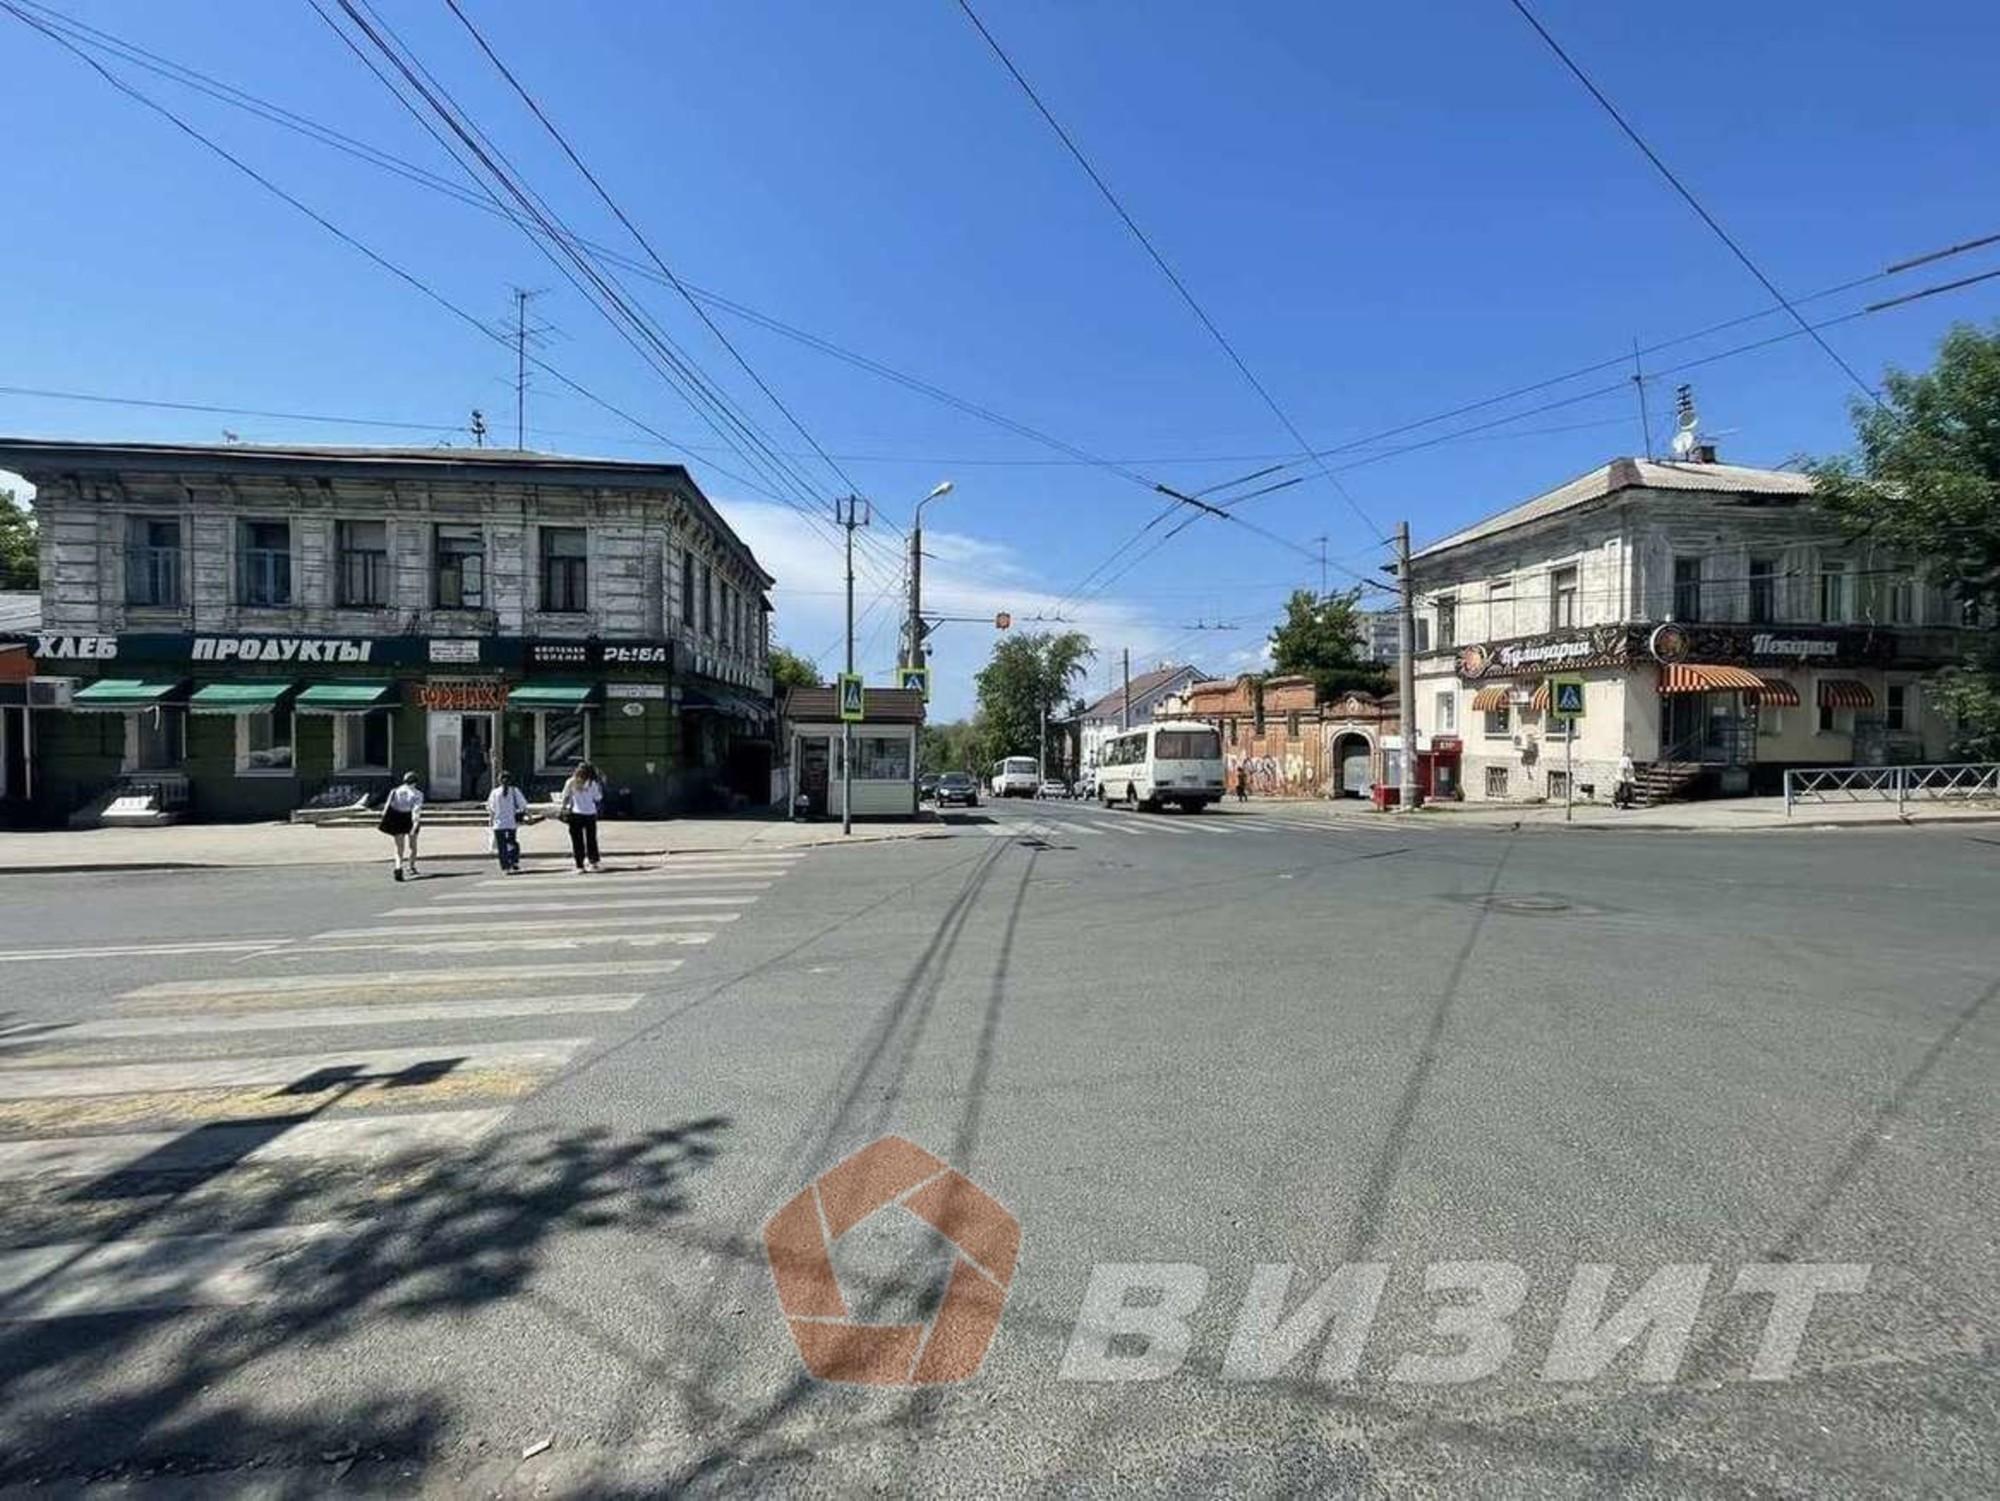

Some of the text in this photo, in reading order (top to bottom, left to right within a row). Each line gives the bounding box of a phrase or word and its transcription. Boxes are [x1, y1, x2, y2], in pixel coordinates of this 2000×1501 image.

[33, 636, 118, 659] ХЛЕБ
[191, 638, 372, 662] ПРОДУКТЫ
[603, 646, 666, 661] РЫБА
[1752, 633, 1838, 660] Пекарня
